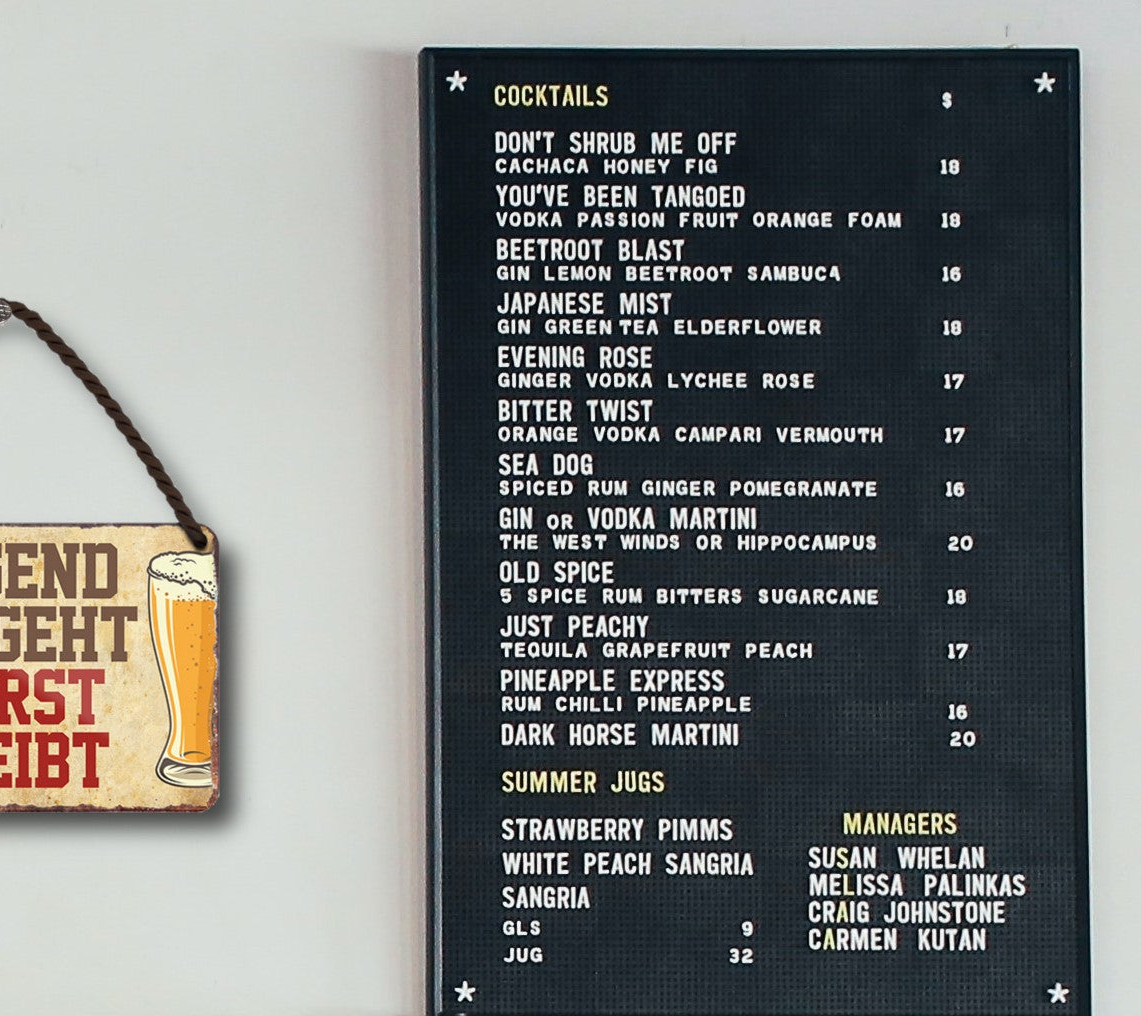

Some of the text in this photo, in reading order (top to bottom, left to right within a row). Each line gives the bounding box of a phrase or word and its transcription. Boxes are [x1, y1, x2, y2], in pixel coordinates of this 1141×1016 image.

[494, 84, 609, 107] COCKTAILS
[494, 130, 737, 155] DON'T SHRUB ME OFF
[495, 157, 960, 176] CACHACA HONEY FIG 18
[495, 183, 746, 209] YOU'VE BEEN TANGOED
[495, 211, 961, 229] VODKA PASSION FRUIT ORANGE FOAM 18
[496, 238, 685, 262] BEETROOT BLAST
[496, 265, 962, 283] GIN LEMON BEETROOT SAMBUCA 16
[496, 291, 672, 316] JAPANESE MIST
[497, 318, 962, 336] GIN GREEN TEA ELDERFLOWER 18
[497, 345, 653, 370] EVENING ROSE
[497, 372, 965, 390] GINGER VODKA LYCHEE ROSE 17
[498, 399, 653, 423] BITTER TWIST
[497, 425, 966, 444] ORANGE VODKA CAMPARI VERMOUTH 17
[498, 453, 594, 476] SEA DOG
[499, 479, 965, 498] SPICED RUM GINGER POMEGRANATE 16
[499, 506, 757, 531] GIN OR VODKA MARTINI
[499, 533, 974, 552] THE WEST WINDS OR HIPPOCAMPUS 20
[499, 560, 615, 584] OLD SPICE
[499, 587, 967, 606] 5 SPICE RUM BITTERS SUGARCANE 18
[499, 614, 649, 639] JUST PEACHY
[500, 641, 969, 660] TEQUILA GRAPEFRUIT PEACH 17
[500, 668, 725, 693] PINEAPPLE EXPRESS
[501, 695, 968, 721] RUM CHILLI PINEAPPLE 16
[501, 722, 977, 748] DARK HORSE MARTINI 20
[501, 770, 665, 794] SUMMER JUGS
[501, 817, 734, 842] STRAWBERRY PIMMS
[843, 812, 958, 836] MANAGERS
[502, 851, 754, 876] WHITE PEACH SANGRIA
[808, 845, 985, 870] SUSAN WHELAN
[502, 885, 591, 910] SANGRIA
[809, 873, 1027, 898] MELISSA PALINKAS
[808, 900, 1006, 925] CRAIG JOHNSTONE
[502, 920, 754, 937] GLS 9
[808, 927, 987, 952] CARMEN KUTAN
[503, 946, 754, 964] JUG 32
